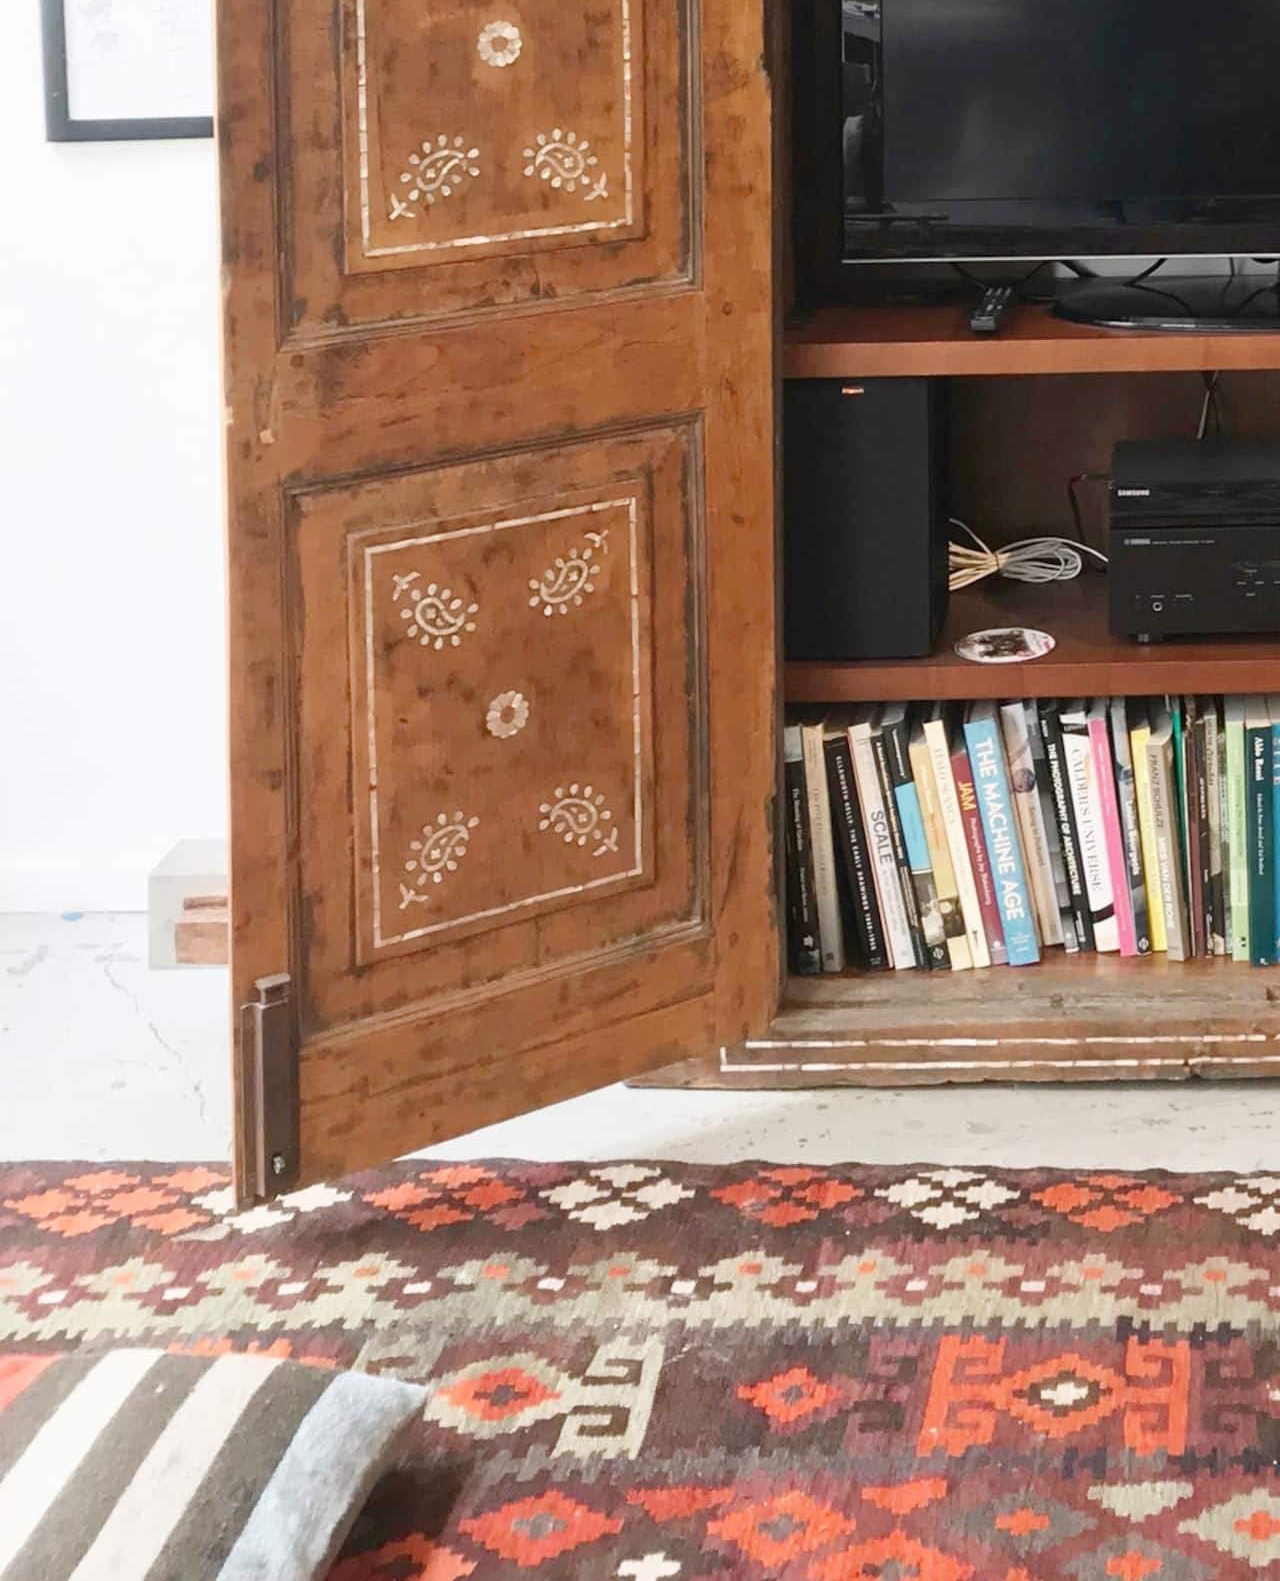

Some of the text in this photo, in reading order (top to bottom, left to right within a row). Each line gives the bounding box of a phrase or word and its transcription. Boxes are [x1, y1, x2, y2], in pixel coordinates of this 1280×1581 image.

[1254, 736, 1263, 756] Aldo
[835, 755, 849, 800] ELLSWORTH
[1150, 754, 1159, 784] FRANZ
[957, 778, 977, 811] JAM
[848, 829, 857, 844] THE
[870, 809, 892, 866] SCALE
[973, 736, 1025, 921] THE MACHINE AGE
[1046, 743, 1082, 896] THE PHOTOGRAPHY OF ARCHITECTURE
[1125, 800, 1140, 875] Louise Bourgeois
[852, 846, 862, 870] EARLY
[1079, 818, 1104, 891] UNIVERSE
[856, 871, 869, 911] DRAWINGS
